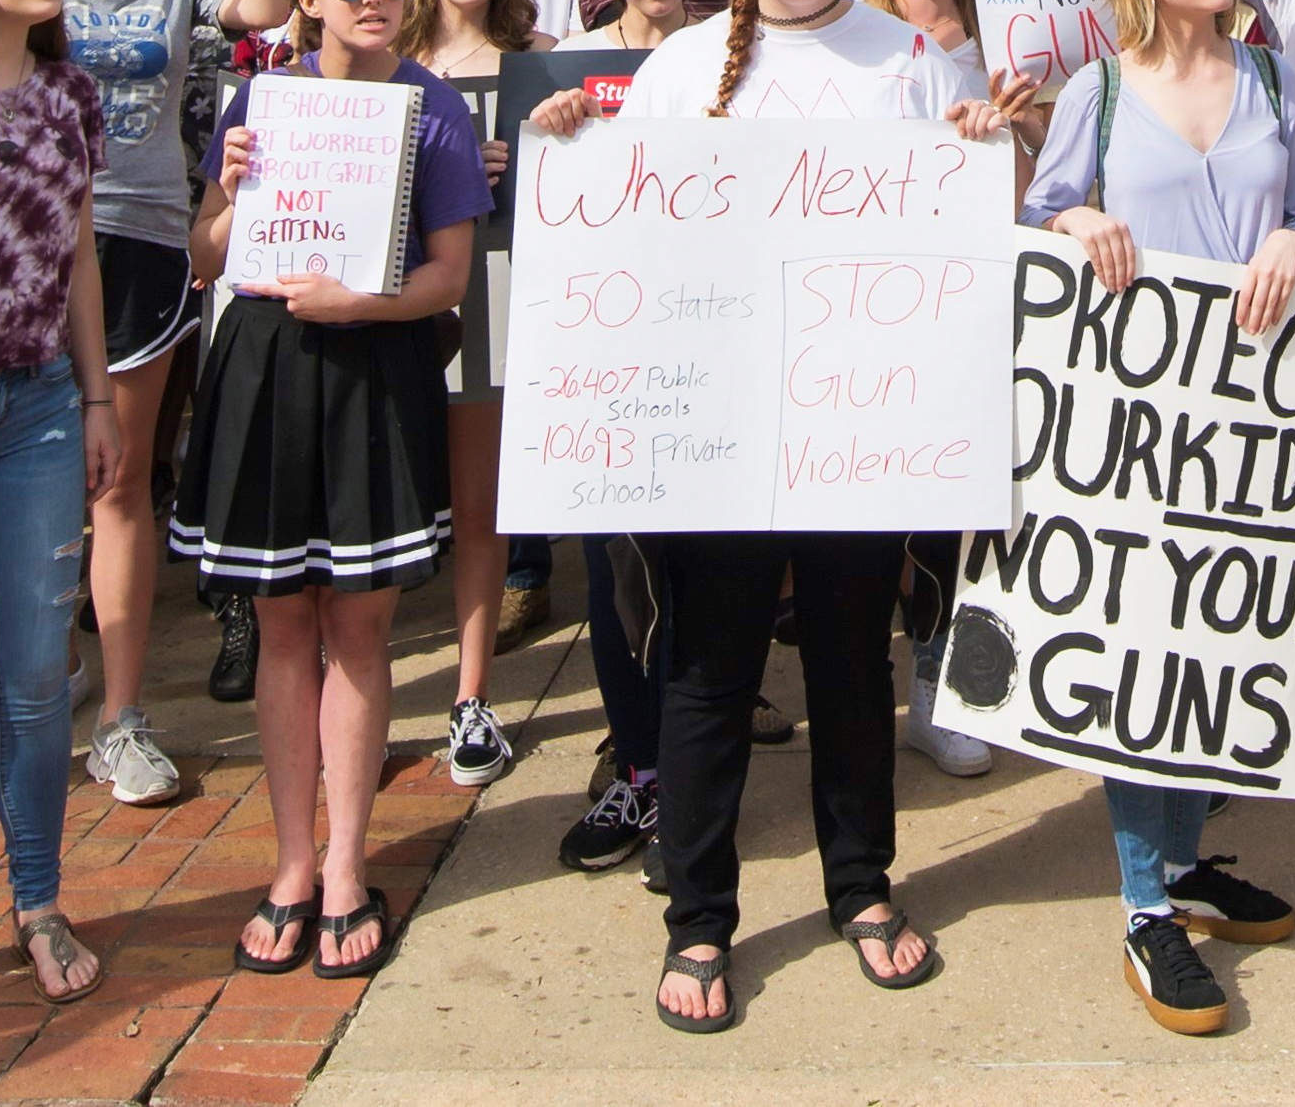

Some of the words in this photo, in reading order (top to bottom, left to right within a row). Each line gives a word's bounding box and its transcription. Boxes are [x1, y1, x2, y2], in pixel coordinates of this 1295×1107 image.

[278, 90, 386, 120] SHOULD
[289, 130, 398, 156] WORRIED
[275, 189, 332, 213] NOT
[535, 139, 734, 230] Who's
[768, 142, 967, 220] Next?
[248, 217, 346, 245] GETTING
[241, 247, 363, 284] SHOT
[554, 268, 644, 330] 50
[800, 260, 976, 333] STOP
[787, 343, 917, 412] Gun
[783, 433, 973, 492] Violence
[963, 511, 1151, 625] NOT
[1027, 630, 1293, 770] GUNS
